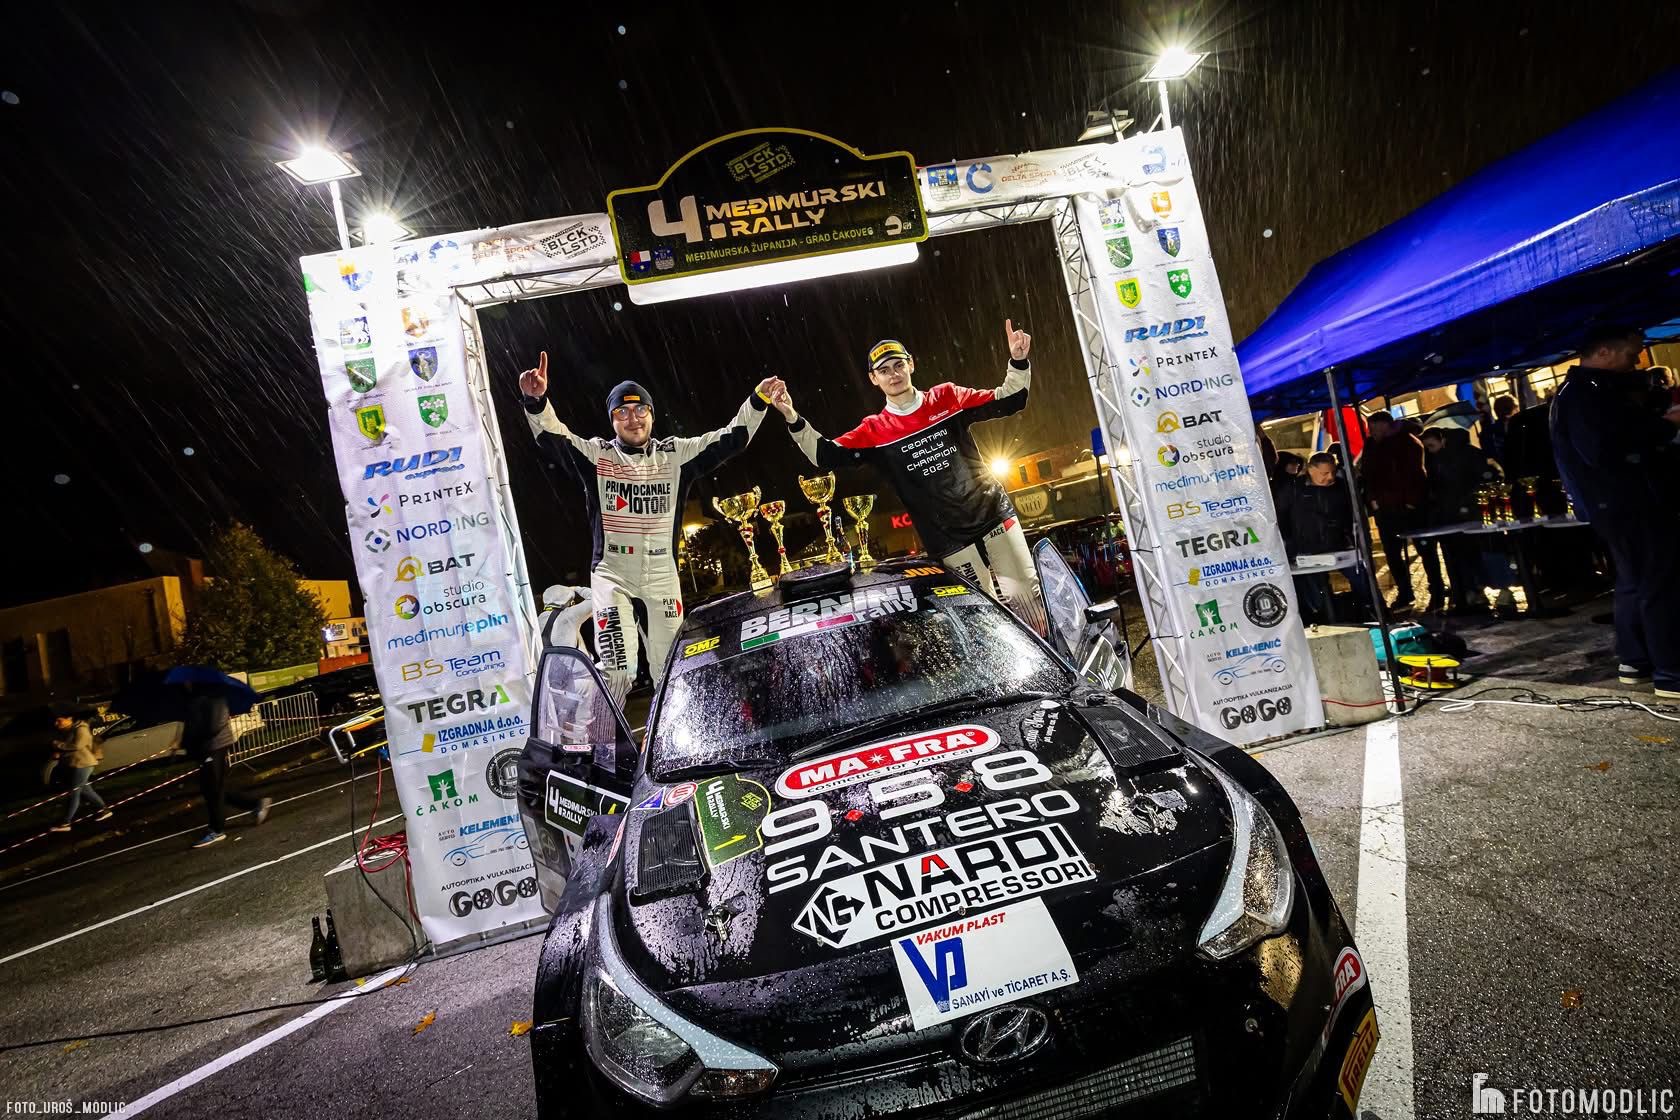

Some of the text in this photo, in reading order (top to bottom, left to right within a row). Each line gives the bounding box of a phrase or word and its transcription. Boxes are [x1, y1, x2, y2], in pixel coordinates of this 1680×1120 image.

[732, 208, 826, 237] RALLY
[548, 227, 588, 250] BLCK
[563, 233, 599, 255] LSTD
[751, 238, 798, 254] ŽUPANIJA
[805, 232, 831, 245] GRAD
[1124, 315, 1206, 343] RUDI
[1182, 410, 1222, 428] BAT
[901, 429, 948, 453] CROATIAN
[912, 441, 944, 459] RALLY
[1196, 434, 1232, 449] studio
[362, 446, 463, 480] RUDI
[906, 445, 958, 472] CHAMPION
[1182, 445, 1234, 463] obscura
[922, 460, 950, 476] 2025
[1201, 495, 1248, 512] Team
[1175, 526, 1260, 558] TEGRA
[427, 553, 475, 575] BAT
[1202, 560, 1249, 577] IZGRADNJA
[443, 580, 485, 598] studio
[932, 585, 970, 597] OMP
[423, 594, 487, 615] obscura
[664, 610, 678, 618] RACE
[740, 585, 915, 641] BERNINI
[855, 597, 918, 622] rally
[684, 638, 720, 656] OMP
[444, 650, 501, 671] Team
[407, 684, 511, 724] TEGRA
[438, 719, 495, 743] IZGRADNJA
[440, 728, 526, 754] DOMAŠINEC
[807, 747, 975, 793] cosmetics for your car
[415, 794, 479, 817] ČAKOM
[766, 789, 1081, 895] SANTERO
[863, 822, 1080, 909] NARDI
[440, 876, 486, 892] AUTOOPTIKA
[875, 860, 1093, 931] COMPRESSORI
[915, 912, 1006, 945] VAKUM PLAST
[951, 987, 991, 1010] SANAYİ
[991, 988, 1005, 999] ve
[1004, 973, 1049, 995] TİCARET
[1342, 1020, 1375, 1101] PIRELLI
